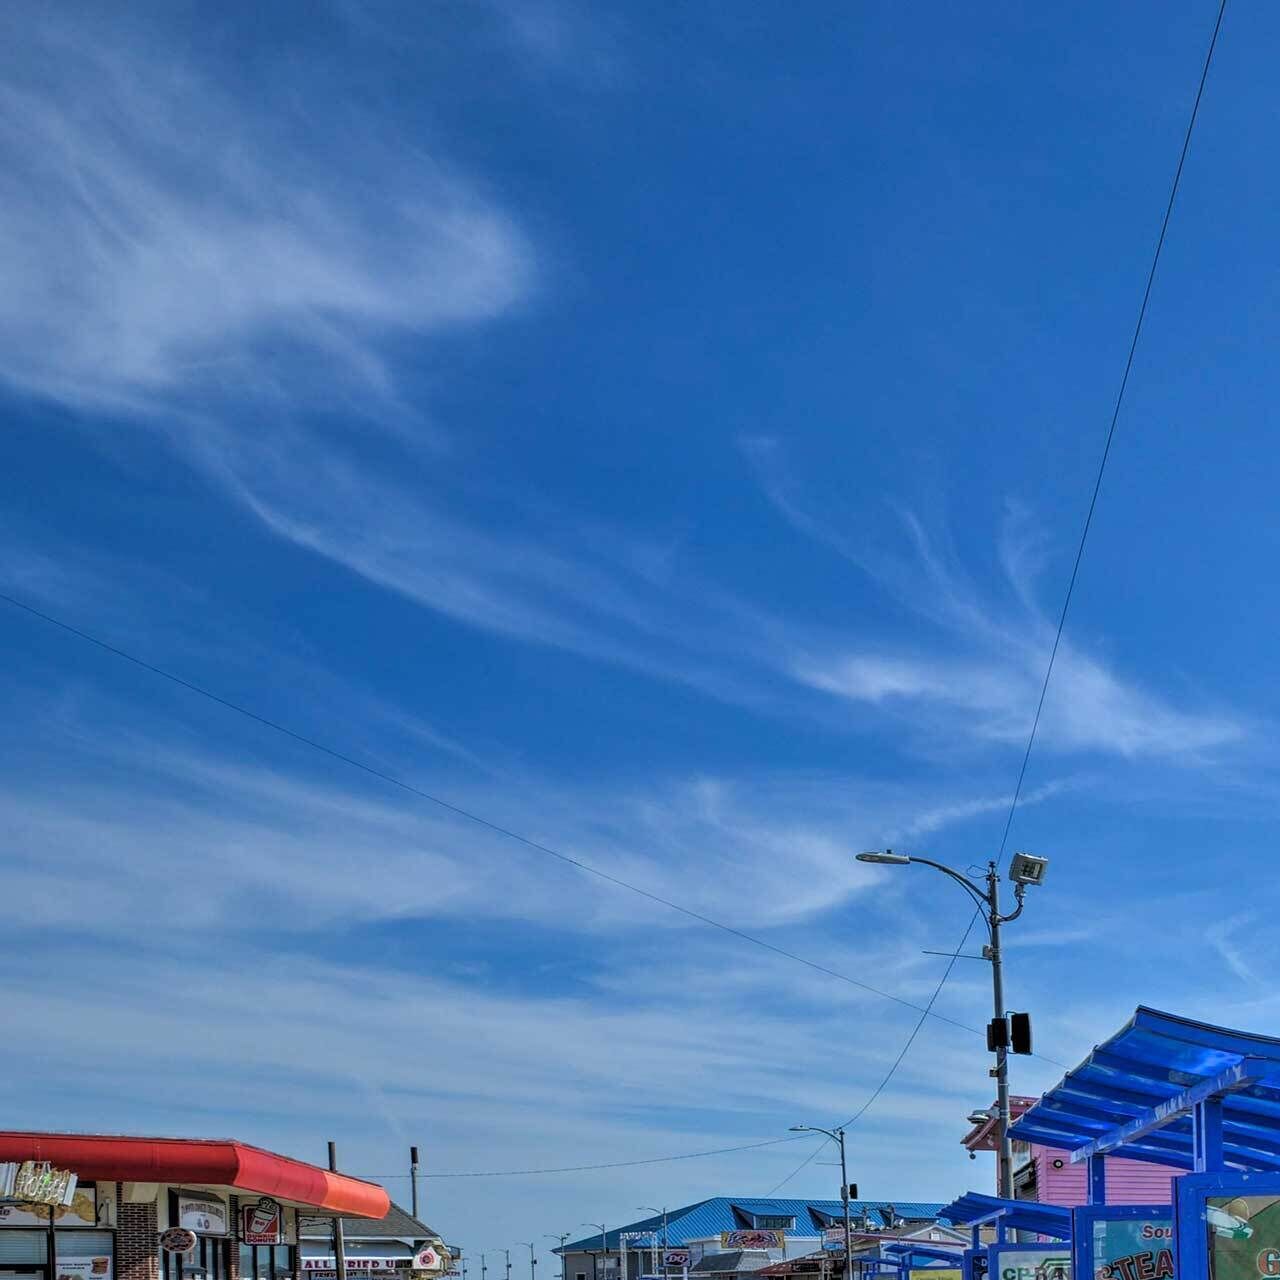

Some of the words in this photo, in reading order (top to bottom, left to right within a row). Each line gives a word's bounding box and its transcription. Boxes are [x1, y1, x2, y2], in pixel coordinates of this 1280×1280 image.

[668, 1254, 685, 1263] DQ
[304, 1260, 331, 1268] ALL
[343, 1260, 380, 1268] RIED
